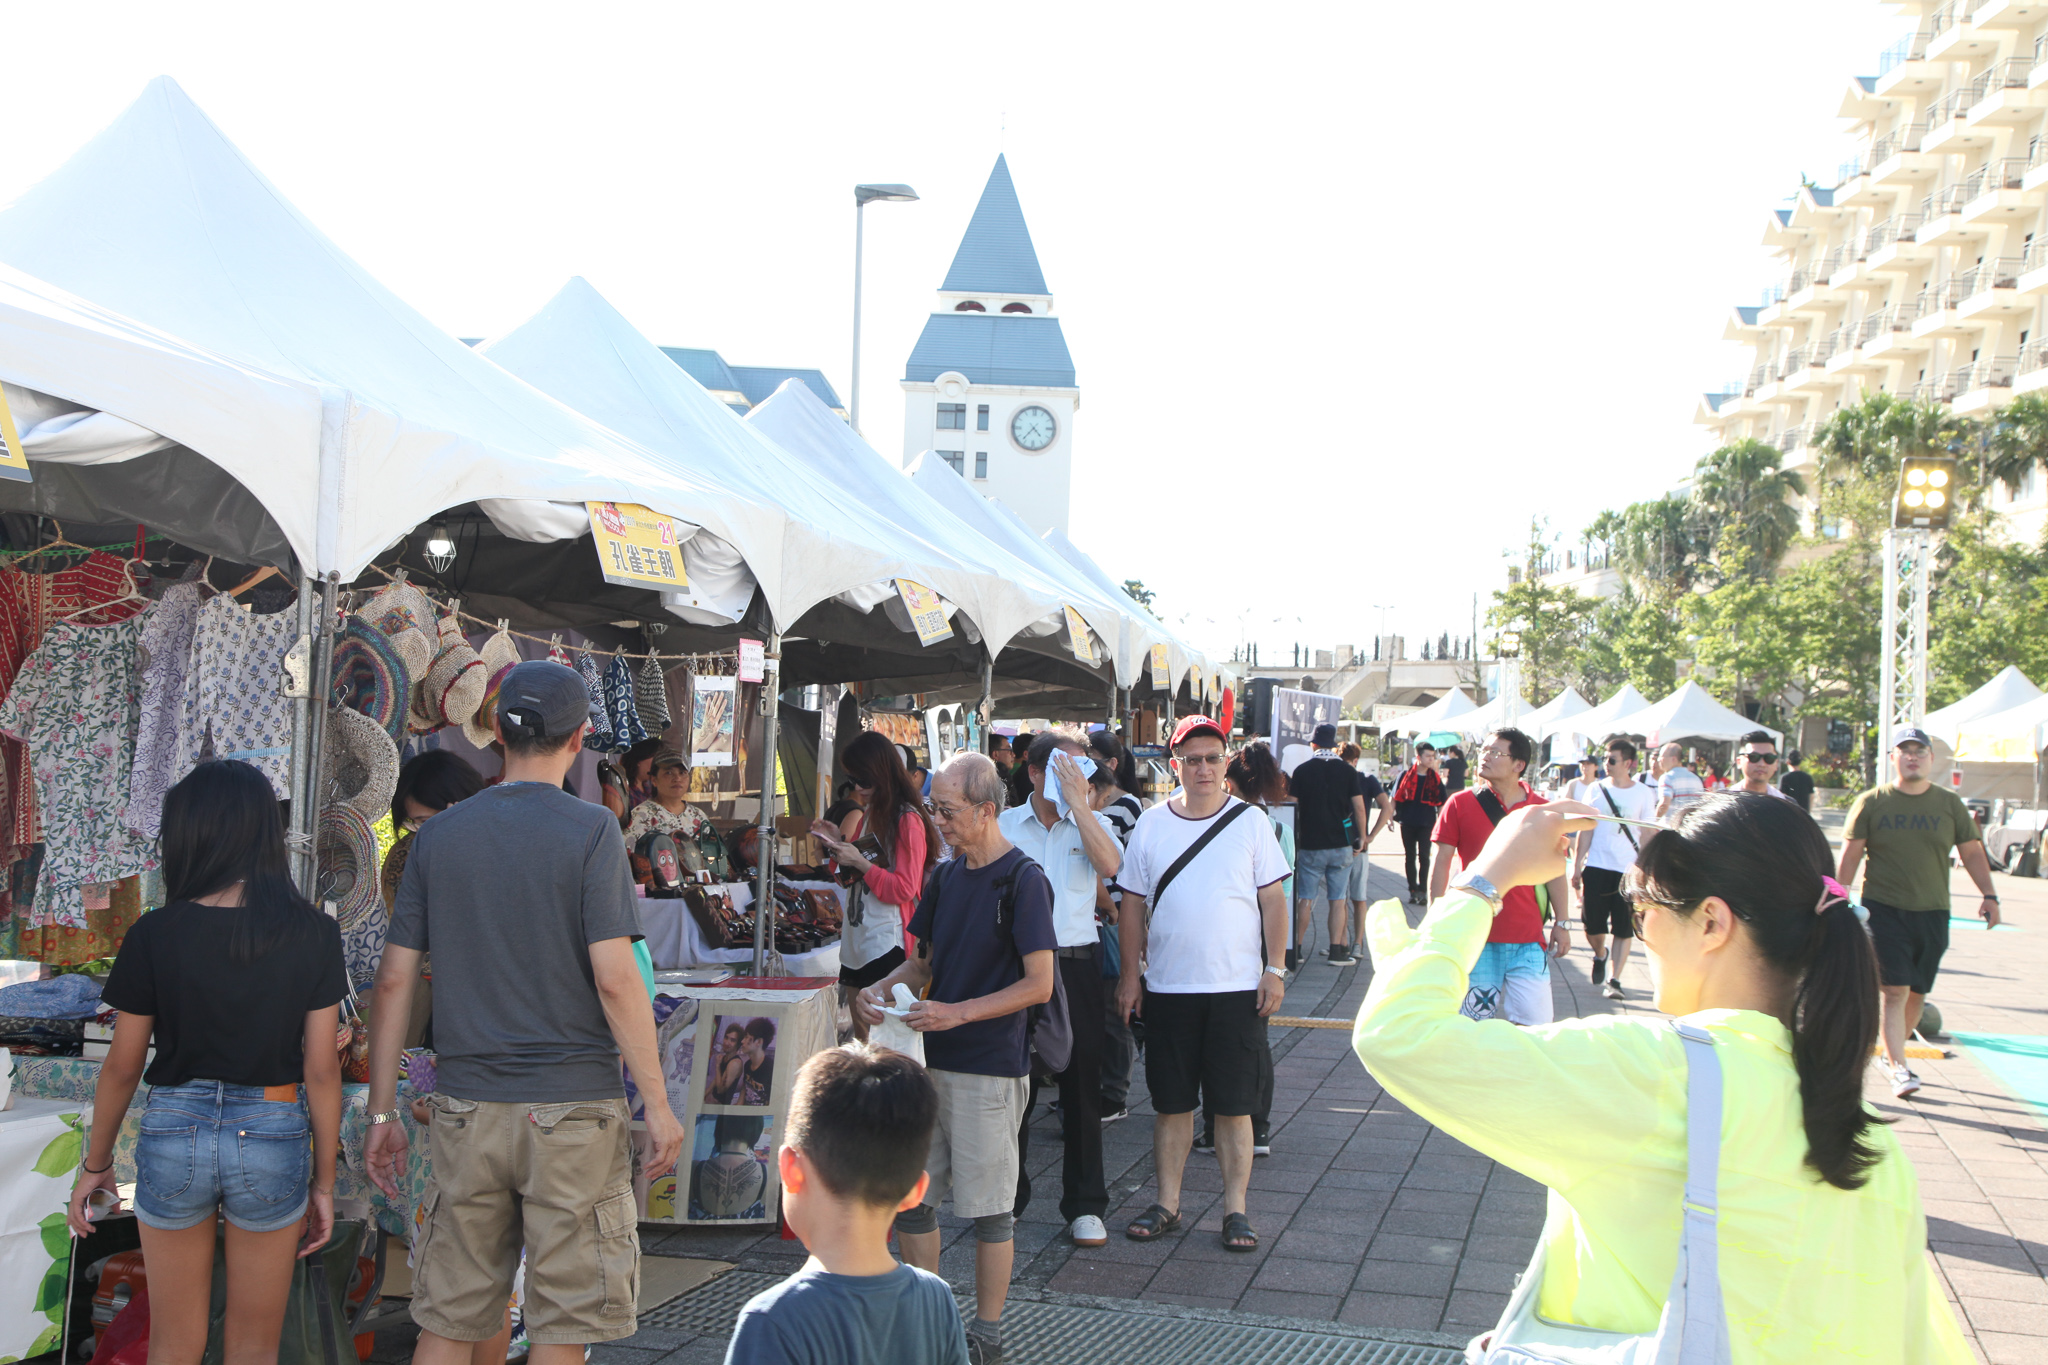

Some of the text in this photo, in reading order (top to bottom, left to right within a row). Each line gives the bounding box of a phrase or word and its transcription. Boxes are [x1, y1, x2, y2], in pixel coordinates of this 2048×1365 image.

[658, 521, 675, 546] 21
[609, 540, 676, 579] 孔雀王朝
[1877, 814, 1942, 831] ARMY
